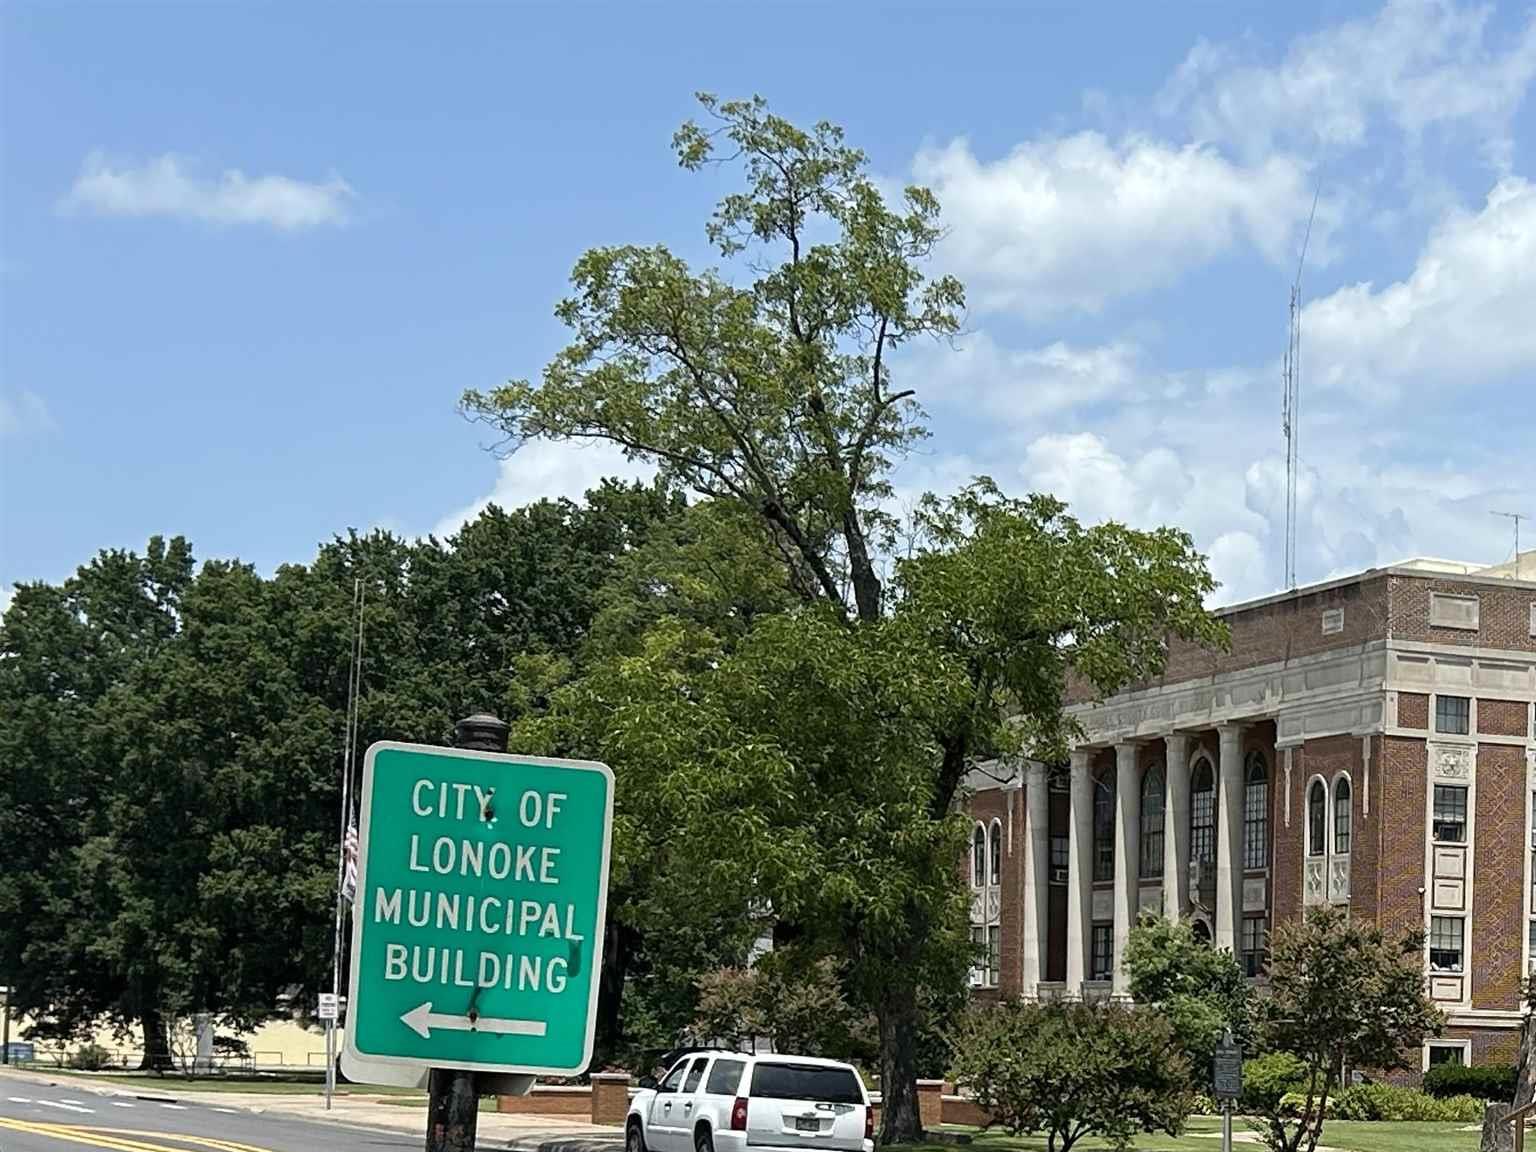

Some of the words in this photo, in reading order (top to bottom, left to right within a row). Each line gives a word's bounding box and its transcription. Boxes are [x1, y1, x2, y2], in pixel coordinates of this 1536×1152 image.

[412, 779, 495, 822] CITY
[519, 790, 568, 829] OF
[409, 834, 561, 884] LONOKE
[374, 887, 584, 941] MUNICIPAL
[384, 943, 569, 993] BUILDING
